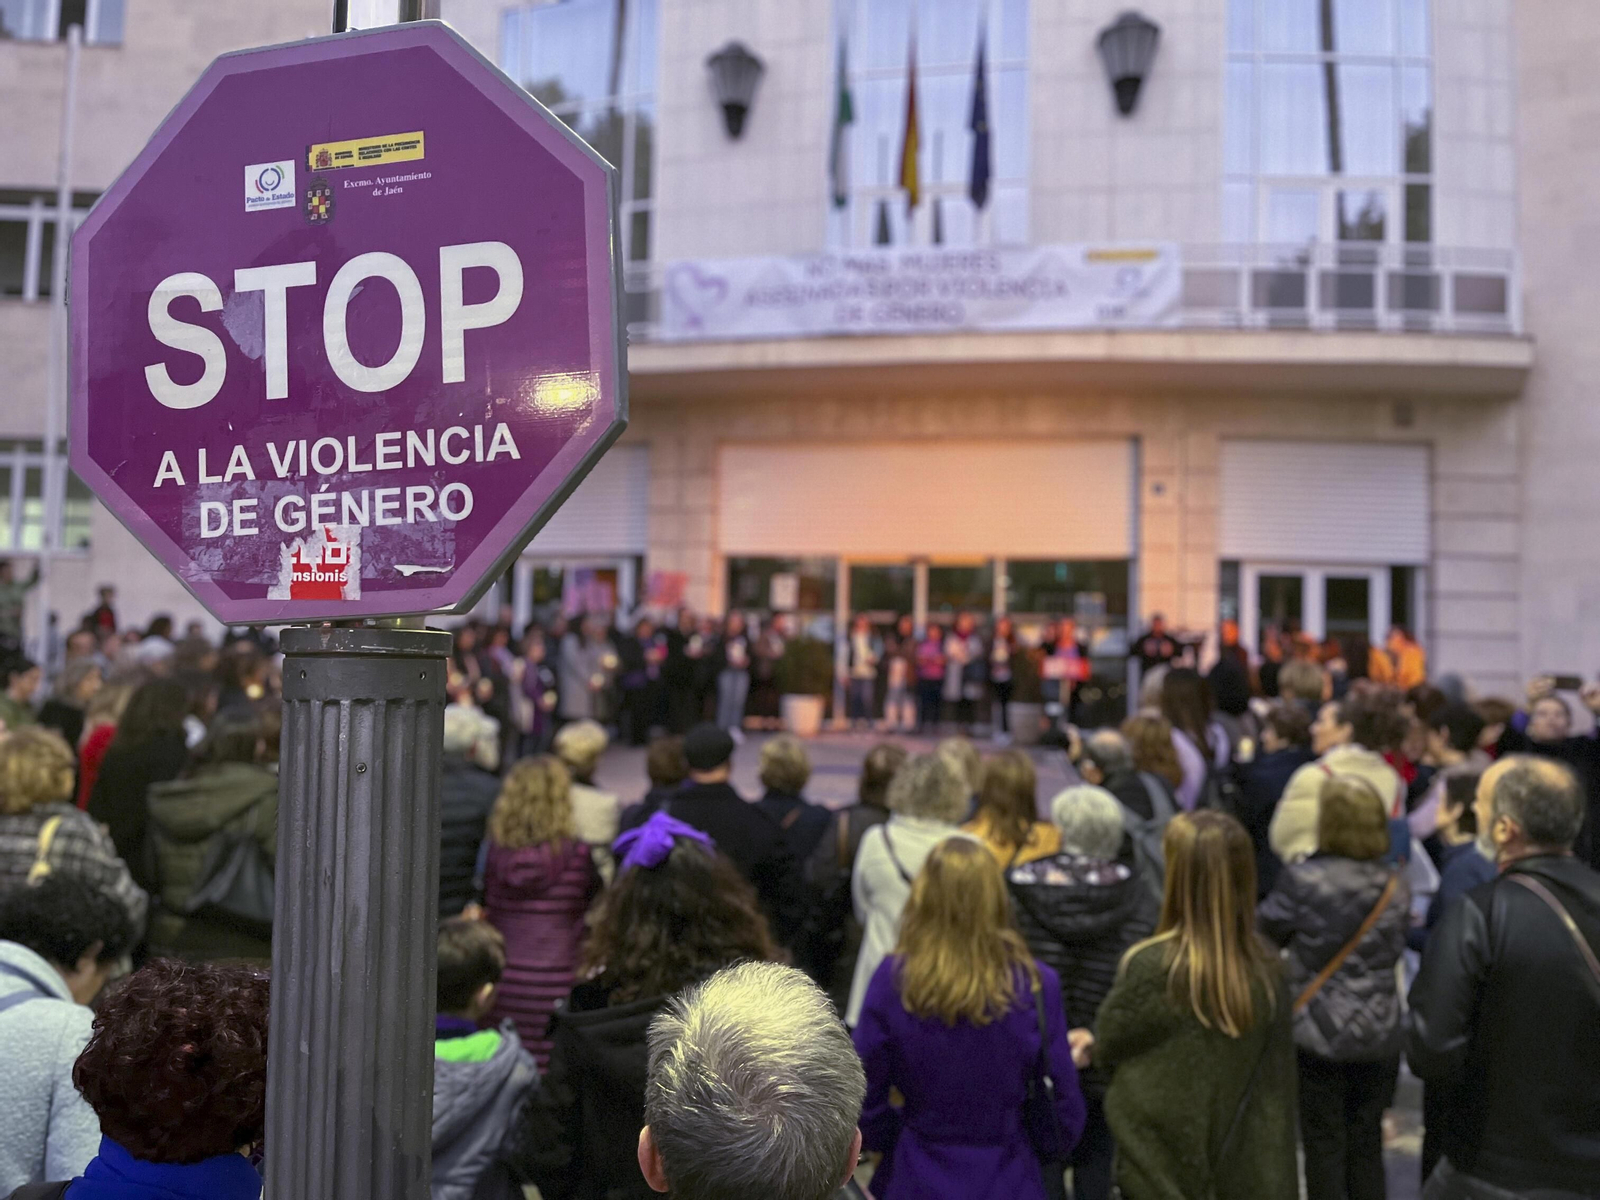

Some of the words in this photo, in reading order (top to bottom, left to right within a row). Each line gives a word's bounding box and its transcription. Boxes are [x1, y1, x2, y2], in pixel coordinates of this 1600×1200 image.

[246, 196, 264, 204] Pacto
[272, 192, 295, 201] Estado
[343, 180, 374, 189] Excmo.
[375, 171, 432, 186] Ayuntamiento
[372, 188, 382, 197] de
[384, 185, 403, 196] Jaén
[144, 241, 524, 410] STOP
[153, 450, 186, 488] A
[198, 444, 256, 485] LA
[266, 422, 521, 479] VIOLENCIA
[199, 498, 259, 539] DE
[274, 482, 474, 534] GÉNERO
